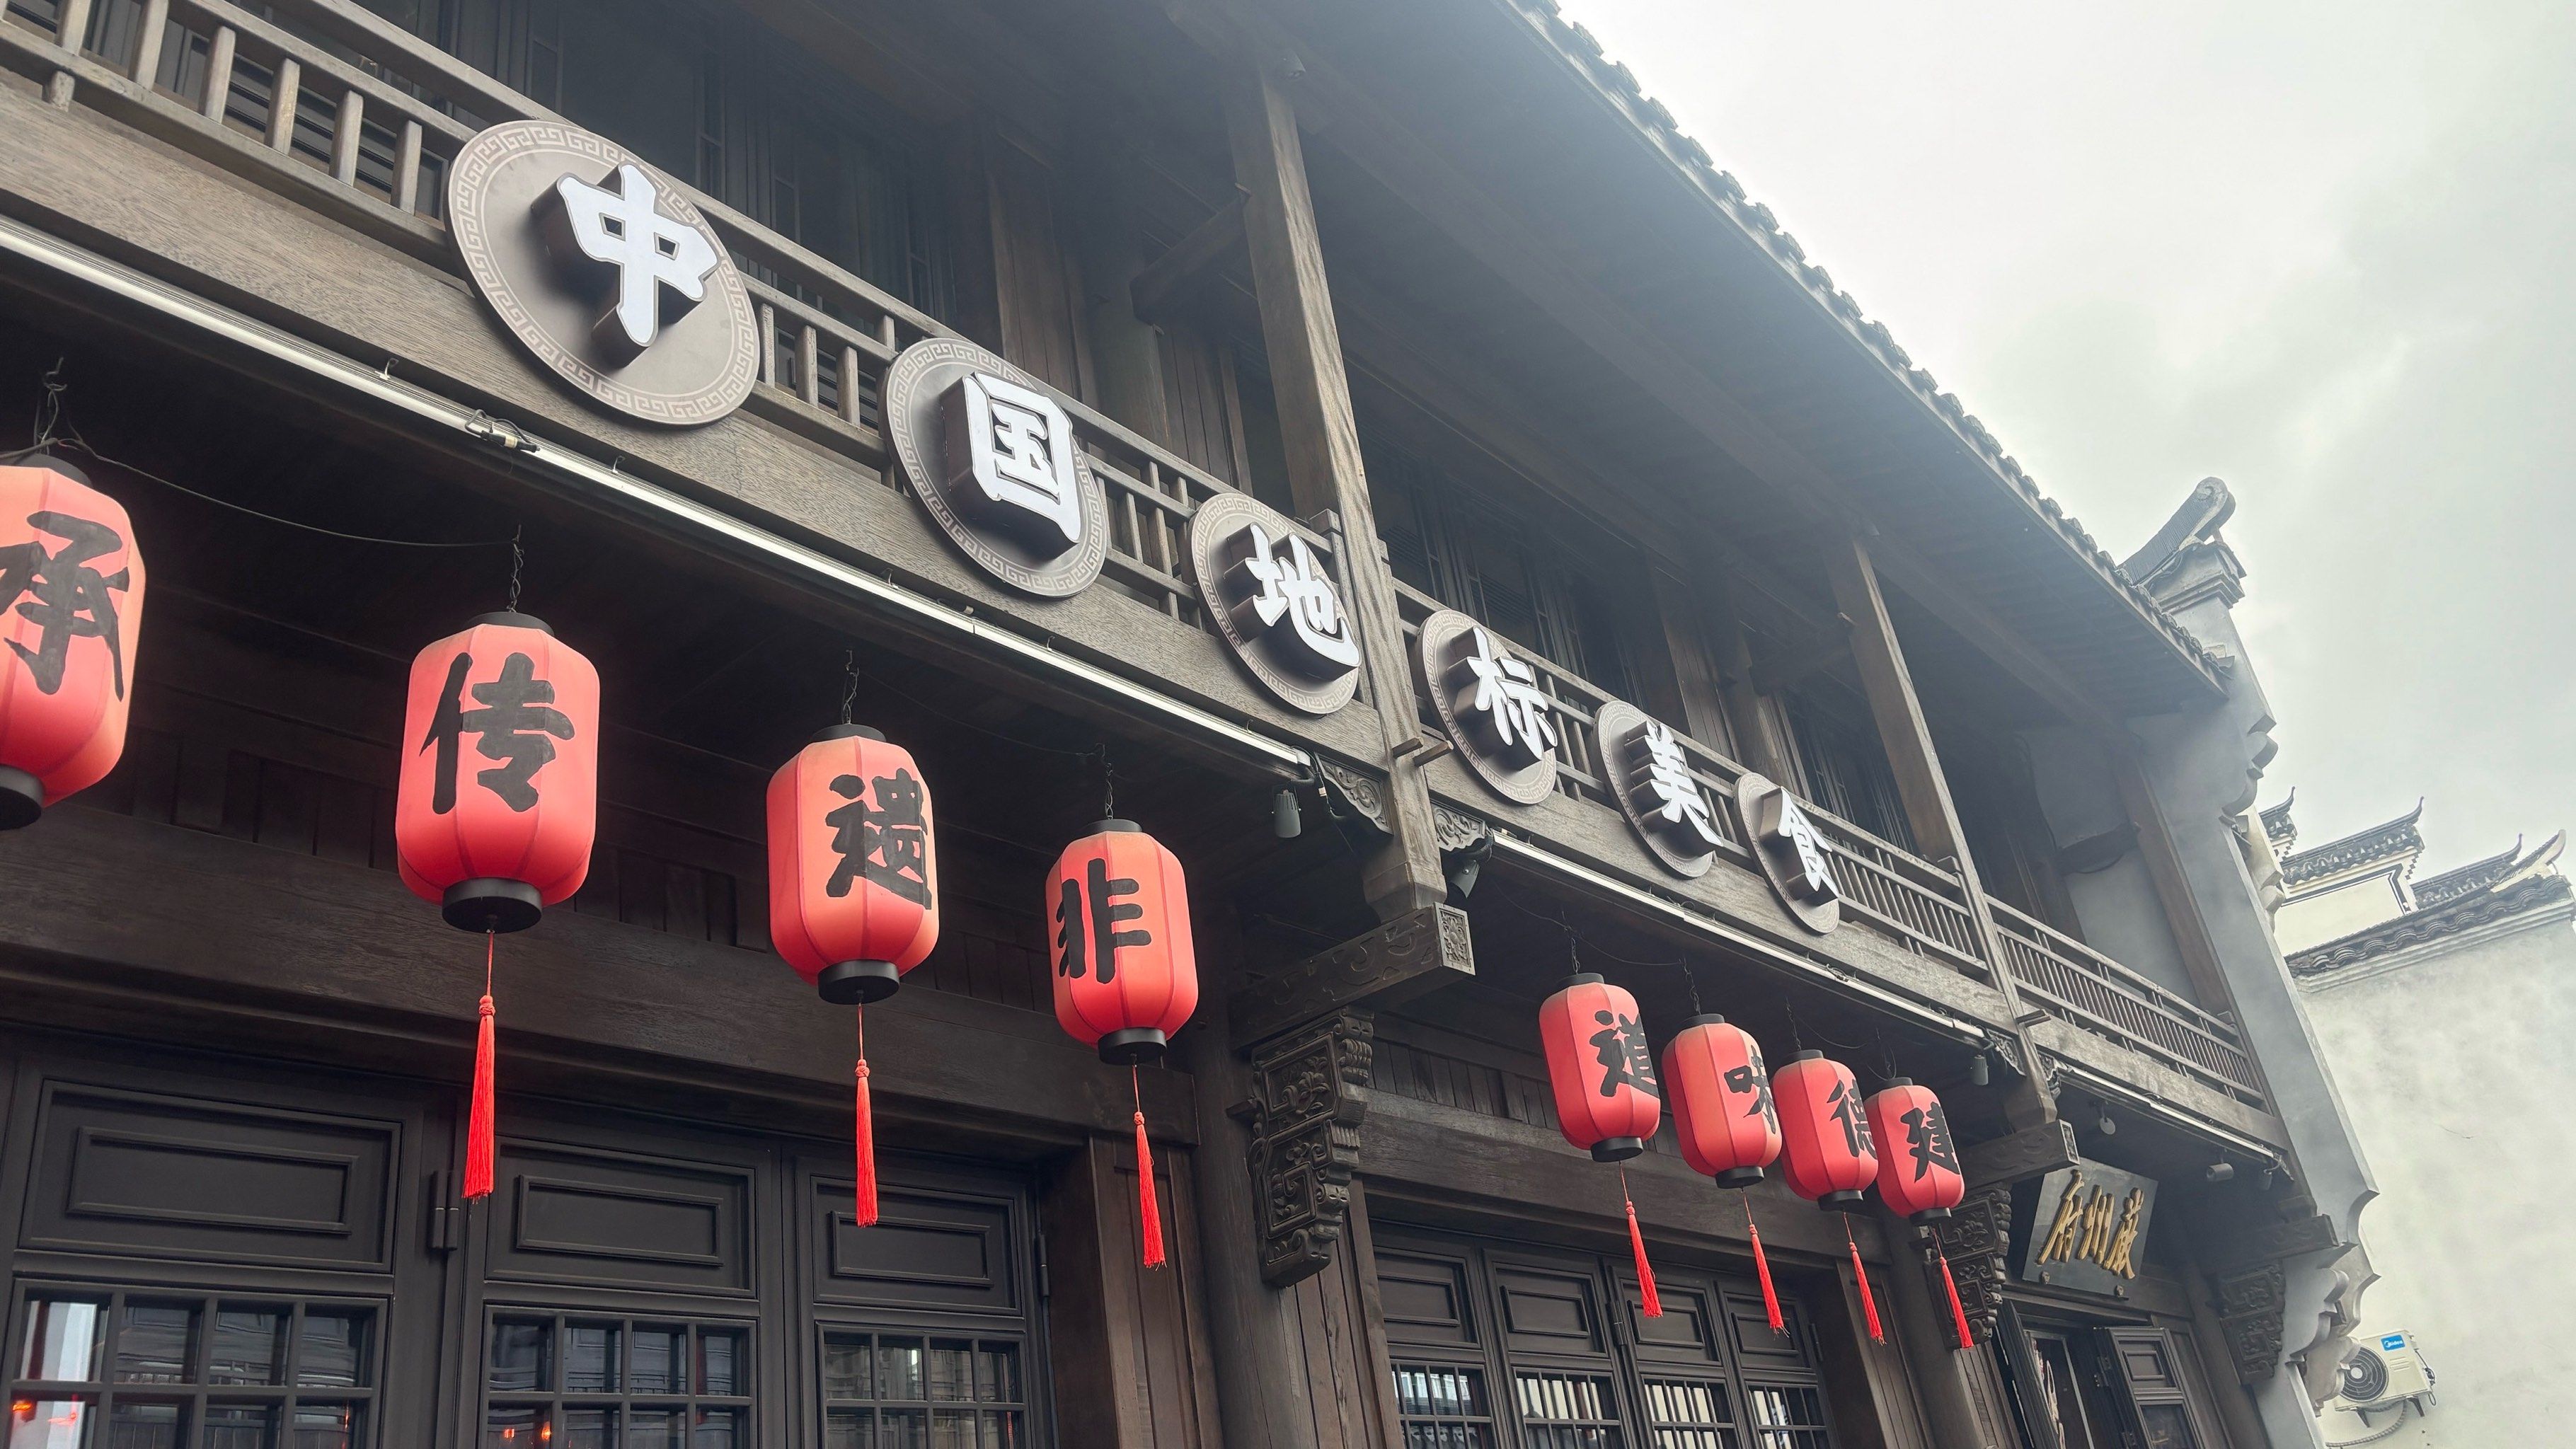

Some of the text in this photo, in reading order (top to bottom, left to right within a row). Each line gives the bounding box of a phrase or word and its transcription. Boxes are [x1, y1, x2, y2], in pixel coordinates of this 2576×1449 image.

[559, 163, 1839, 899] 中 国 地 标 美 食
[0, 511, 130, 702] 承
[420, 652, 575, 814] 传
[1057, 858, 1151, 984] 非
[1589, 1010, 1660, 1099] 道
[1724, 1044, 1777, 1134] 味
[1900, 1101, 1960, 1183] 建
